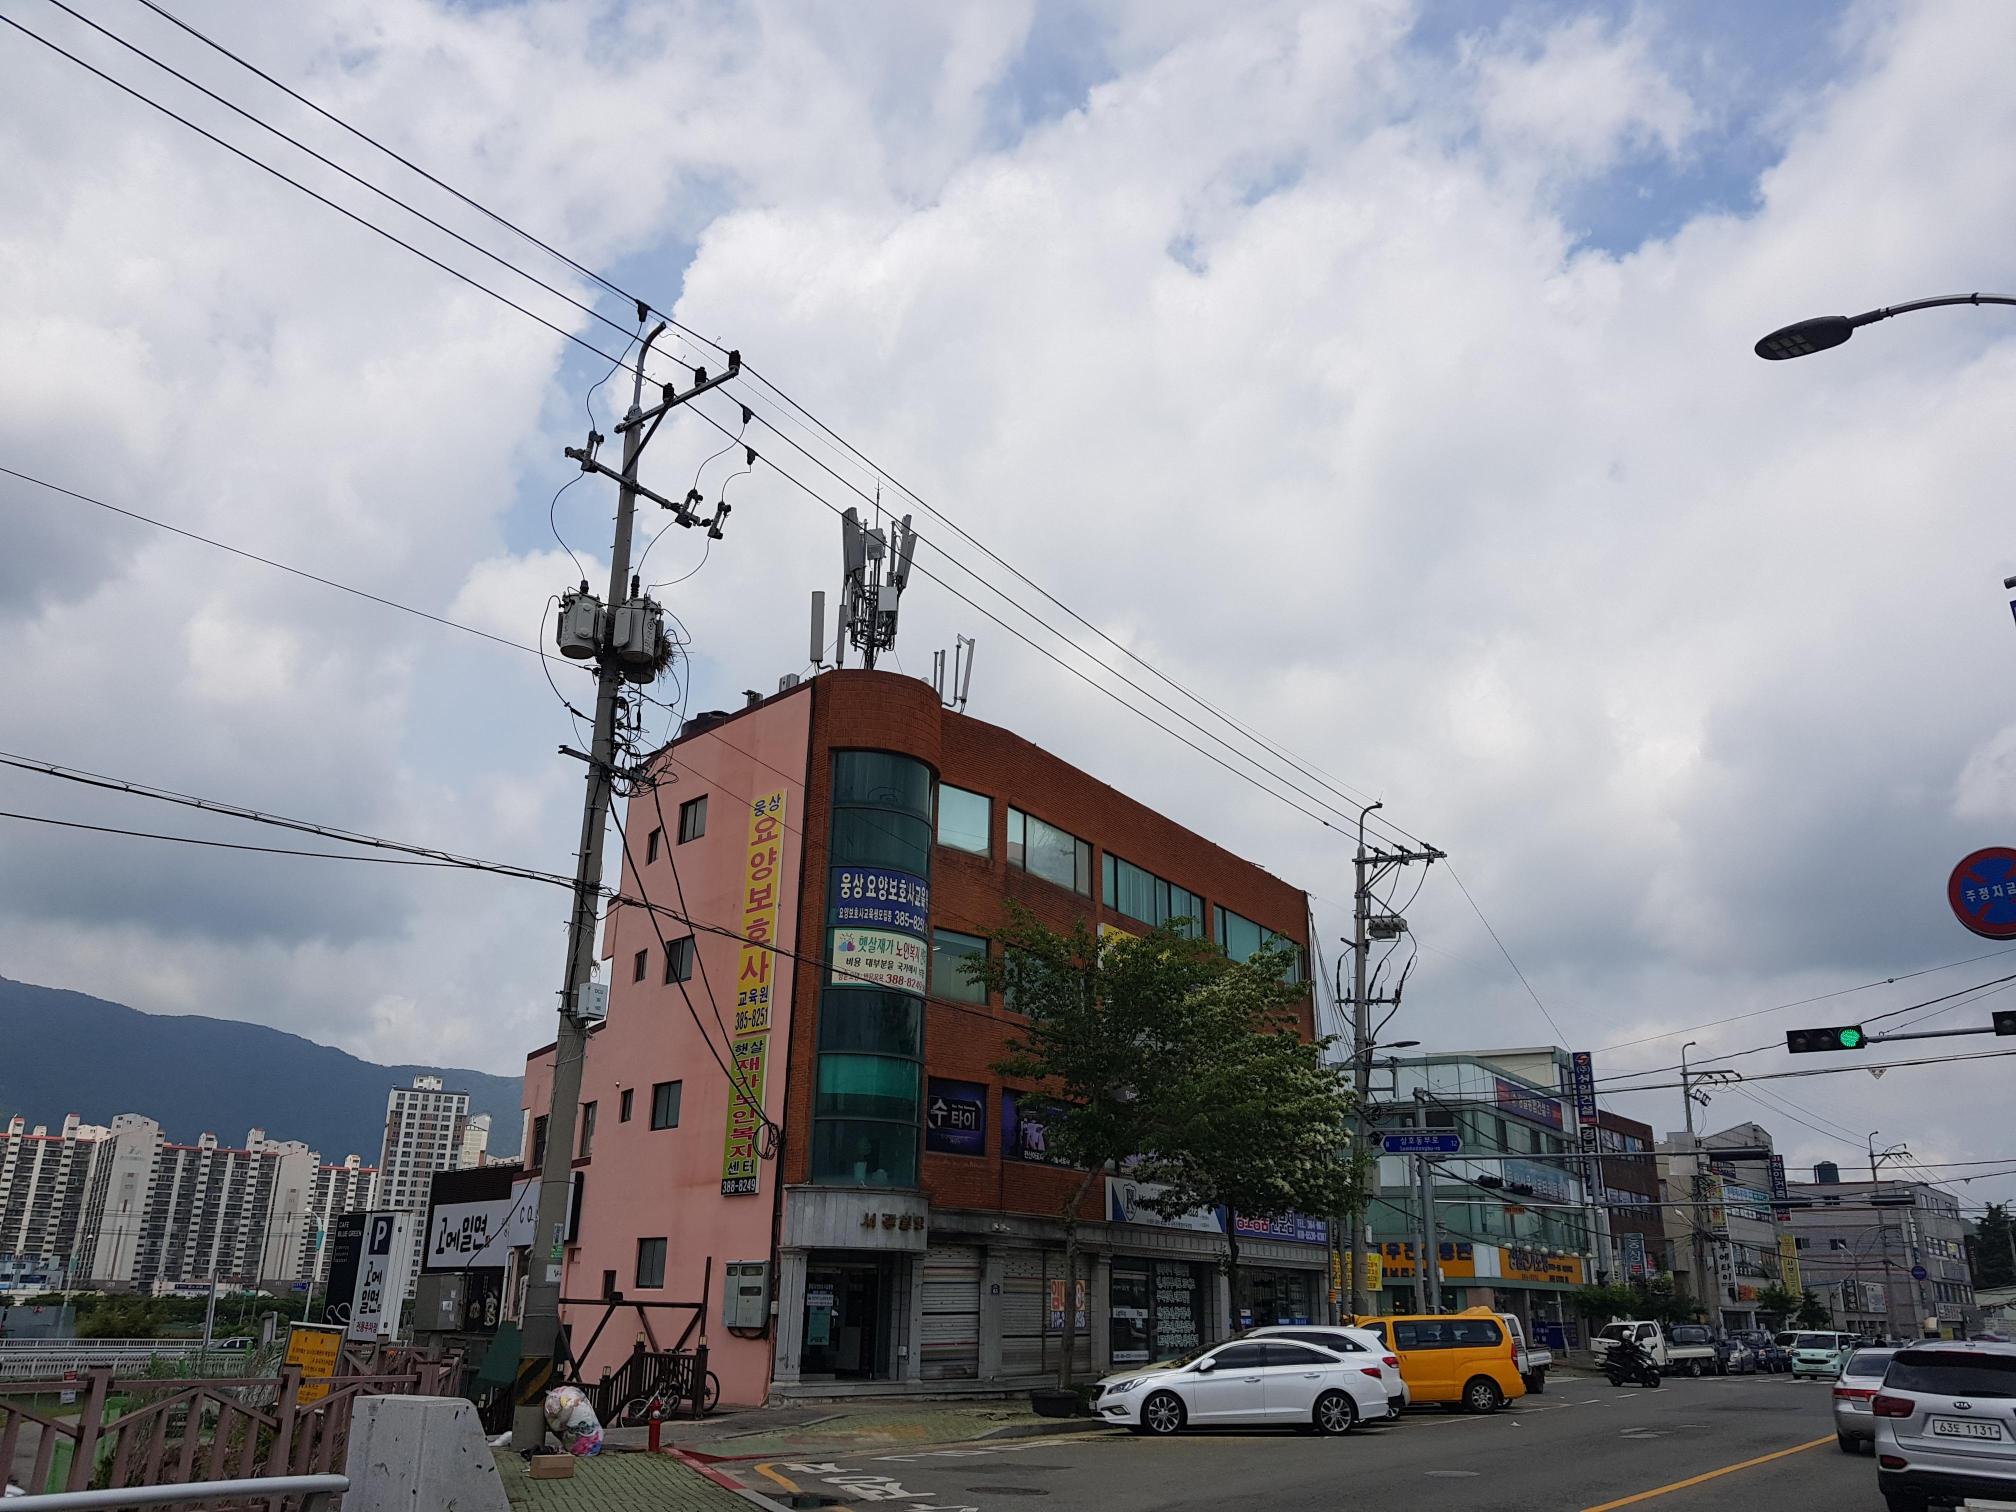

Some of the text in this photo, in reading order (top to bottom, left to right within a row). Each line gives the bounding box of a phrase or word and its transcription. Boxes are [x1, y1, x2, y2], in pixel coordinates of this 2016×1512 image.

[753, 795, 781, 816] 웅상
[840, 873, 863, 899] 웅상
[741, 816, 779, 984] 요양보호사
[846, 957, 861, 968] 비용
[738, 986, 768, 1007] 교육원
[735, 1007, 768, 1031] 385-8251
[735, 1040, 763, 1056] 햇살
[951, 1110, 975, 1129] 타이
[728, 1159, 754, 1175] 센터
[722, 1178, 756, 1193] 388-8249
[374, 1221, 387, 1251] P
[1966, 1425, 1993, 1437] 1131
